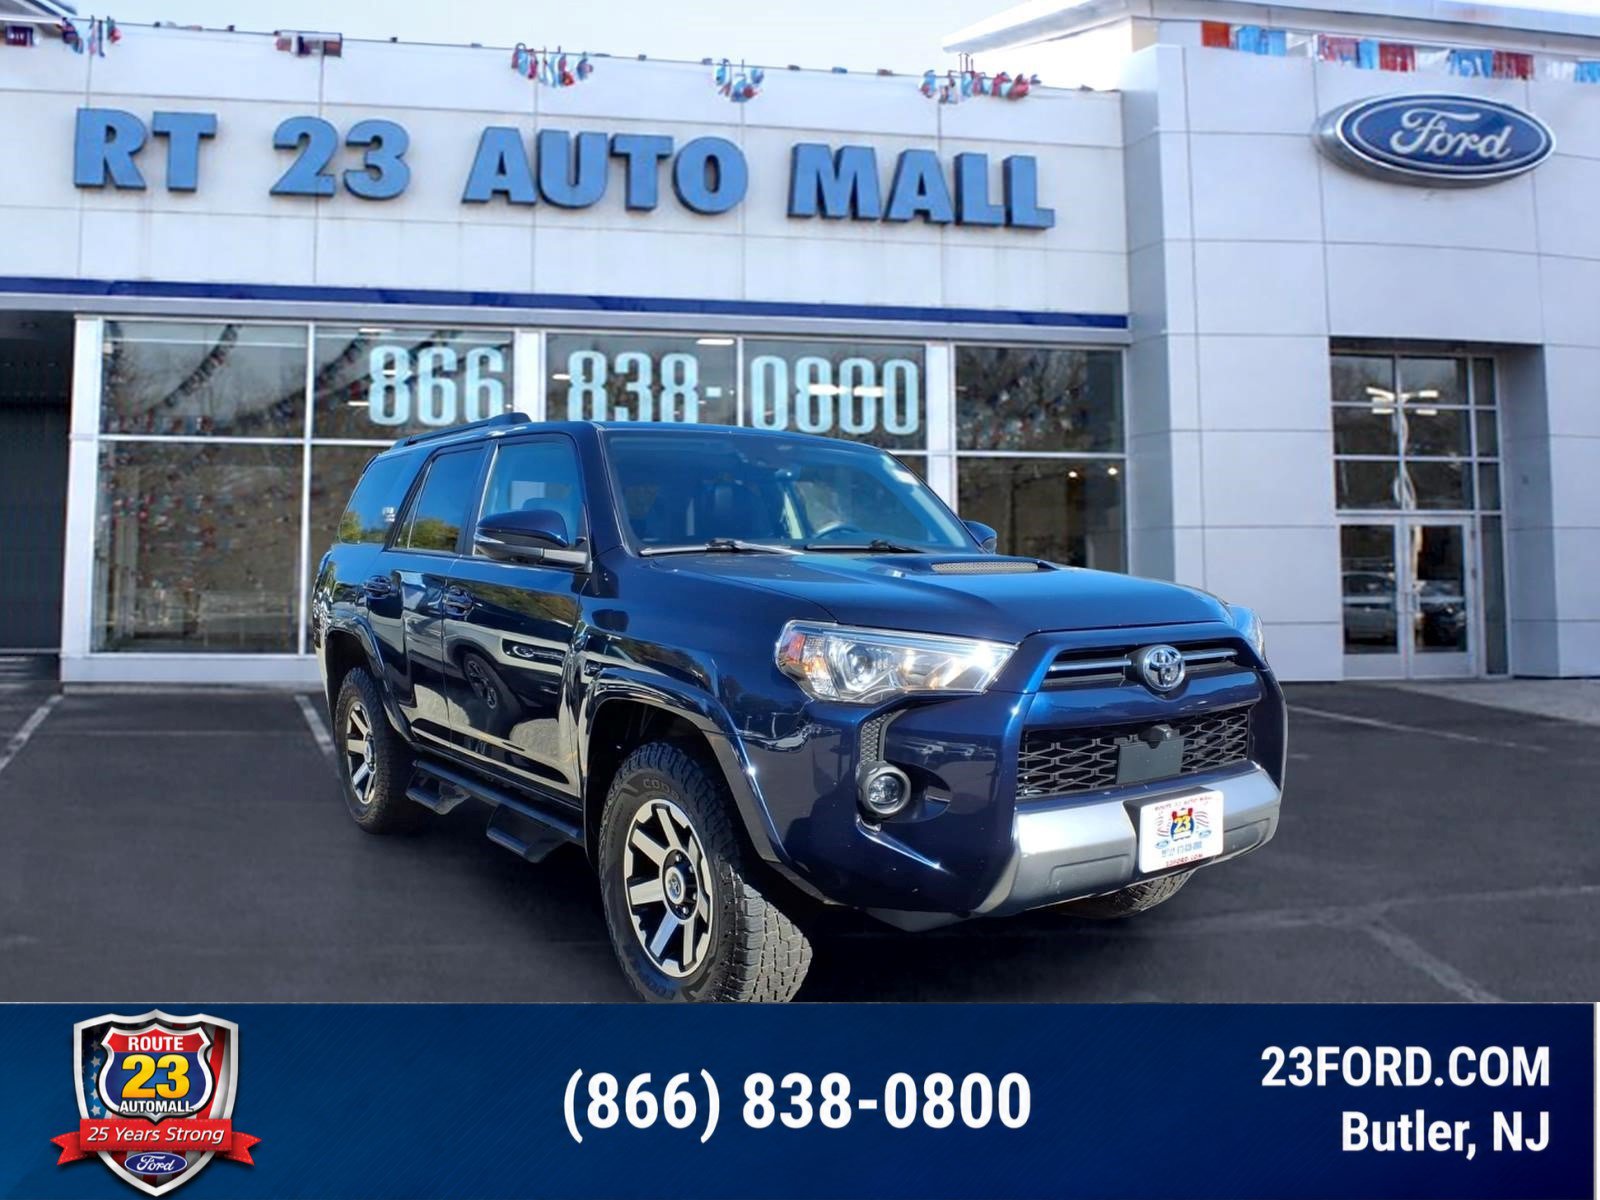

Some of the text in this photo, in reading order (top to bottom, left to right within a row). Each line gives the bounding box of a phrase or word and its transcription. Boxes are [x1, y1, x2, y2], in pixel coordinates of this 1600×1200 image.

[74, 108, 1055, 229] RT 23 AUTO MALL
[1390, 108, 1513, 159] Ford
[369, 344, 505, 426] 866
